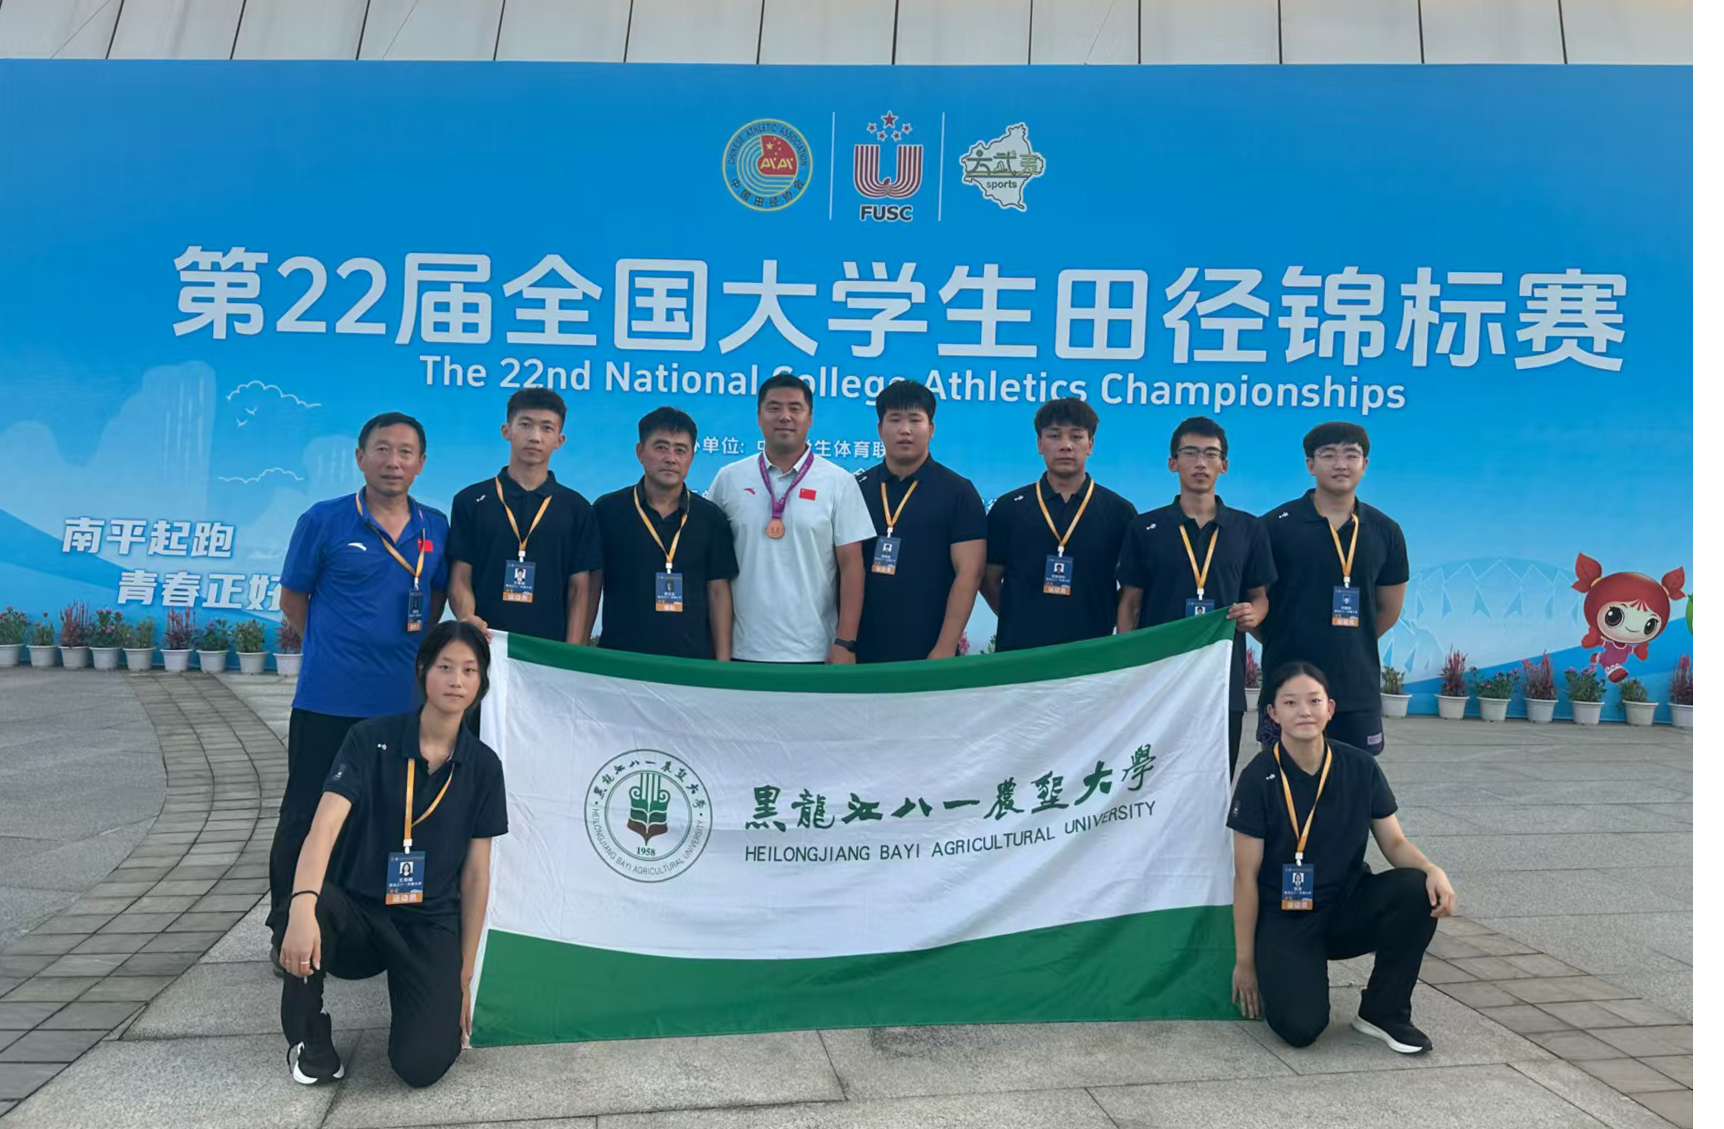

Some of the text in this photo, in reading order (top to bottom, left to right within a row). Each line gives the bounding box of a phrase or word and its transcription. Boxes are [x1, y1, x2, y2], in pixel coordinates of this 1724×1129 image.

[986, 180, 1018, 189] sports
[860, 205, 913, 221] FUSC
[173, 245, 1627, 372] 第22届全国大学生田径锦标赛
[420, 355, 487, 387] The
[500, 358, 591, 391] 22nd
[605, 361, 758, 397] National
[1100, 373, 1406, 416] Championships
[62, 517, 235, 558] 南平起跑
[117, 570, 281, 611] 青春正好
[591, 808, 705, 876] HEILONGJIANG BAYI AGRICULTURAL UNIVERSITY
[636, 847, 656, 856] 1958
[745, 801, 1157, 863] HEILONGJIANG BAYI AGRICULTURAL UNIVERSITY
